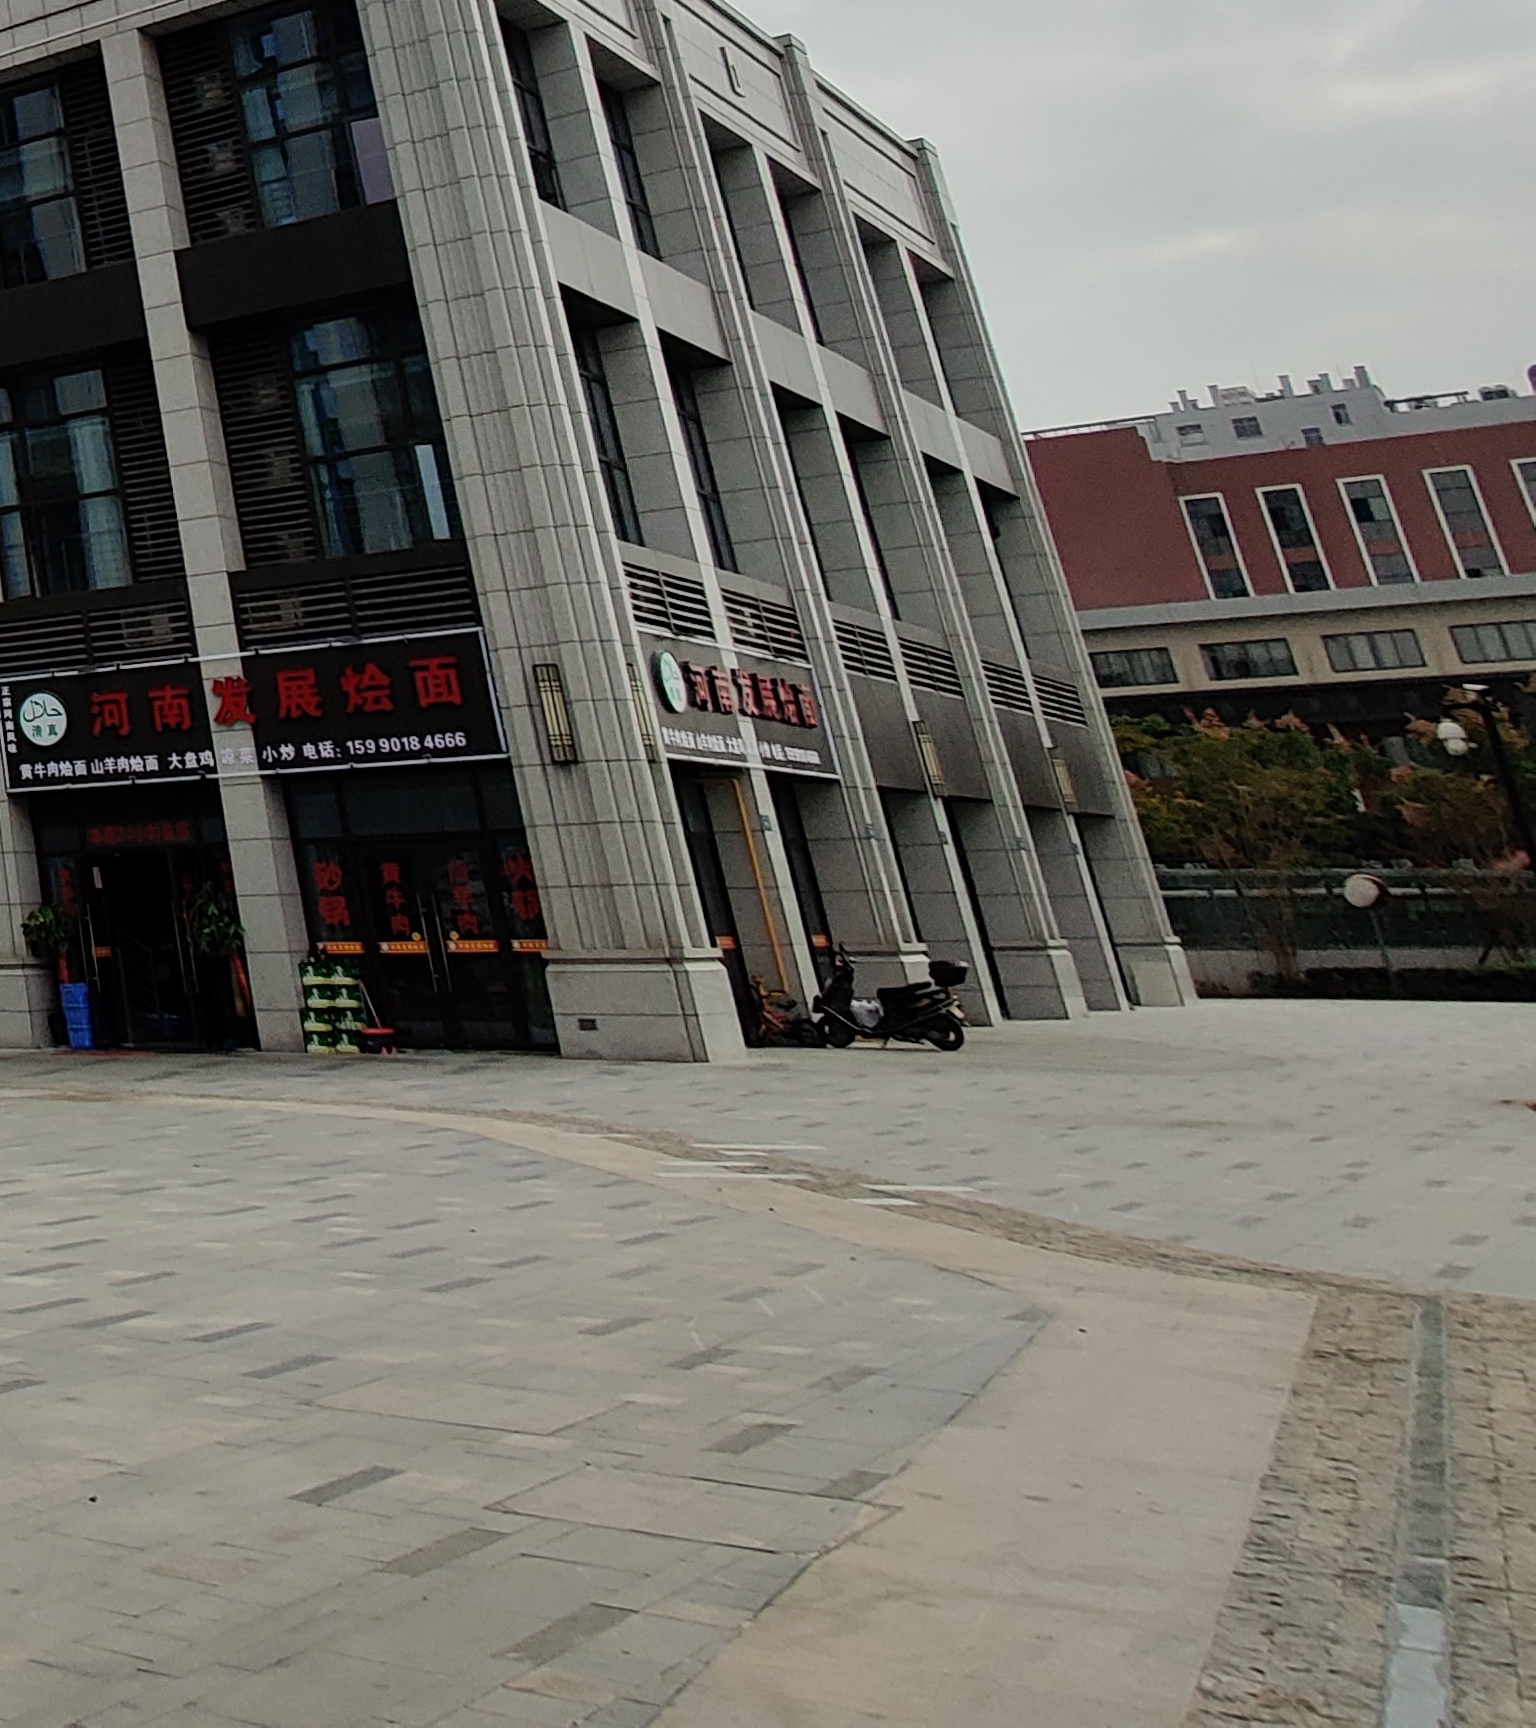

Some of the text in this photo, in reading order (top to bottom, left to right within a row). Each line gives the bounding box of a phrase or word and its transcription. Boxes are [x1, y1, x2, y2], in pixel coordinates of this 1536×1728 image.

[22, 699, 64, 723] حلال
[89, 655, 464, 738] 河南发展烩面
[31, 724, 59, 738] 清真
[19, 759, 88, 780] 黄牛肉烩面
[90, 754, 159, 774] 山羊肉烩面
[167, 749, 216, 770] 大盘鸡
[261, 743, 296, 763] 小炒
[345, 738, 376, 756] 159
[380, 734, 422, 754] 9018
[423, 731, 467, 750] 4666
